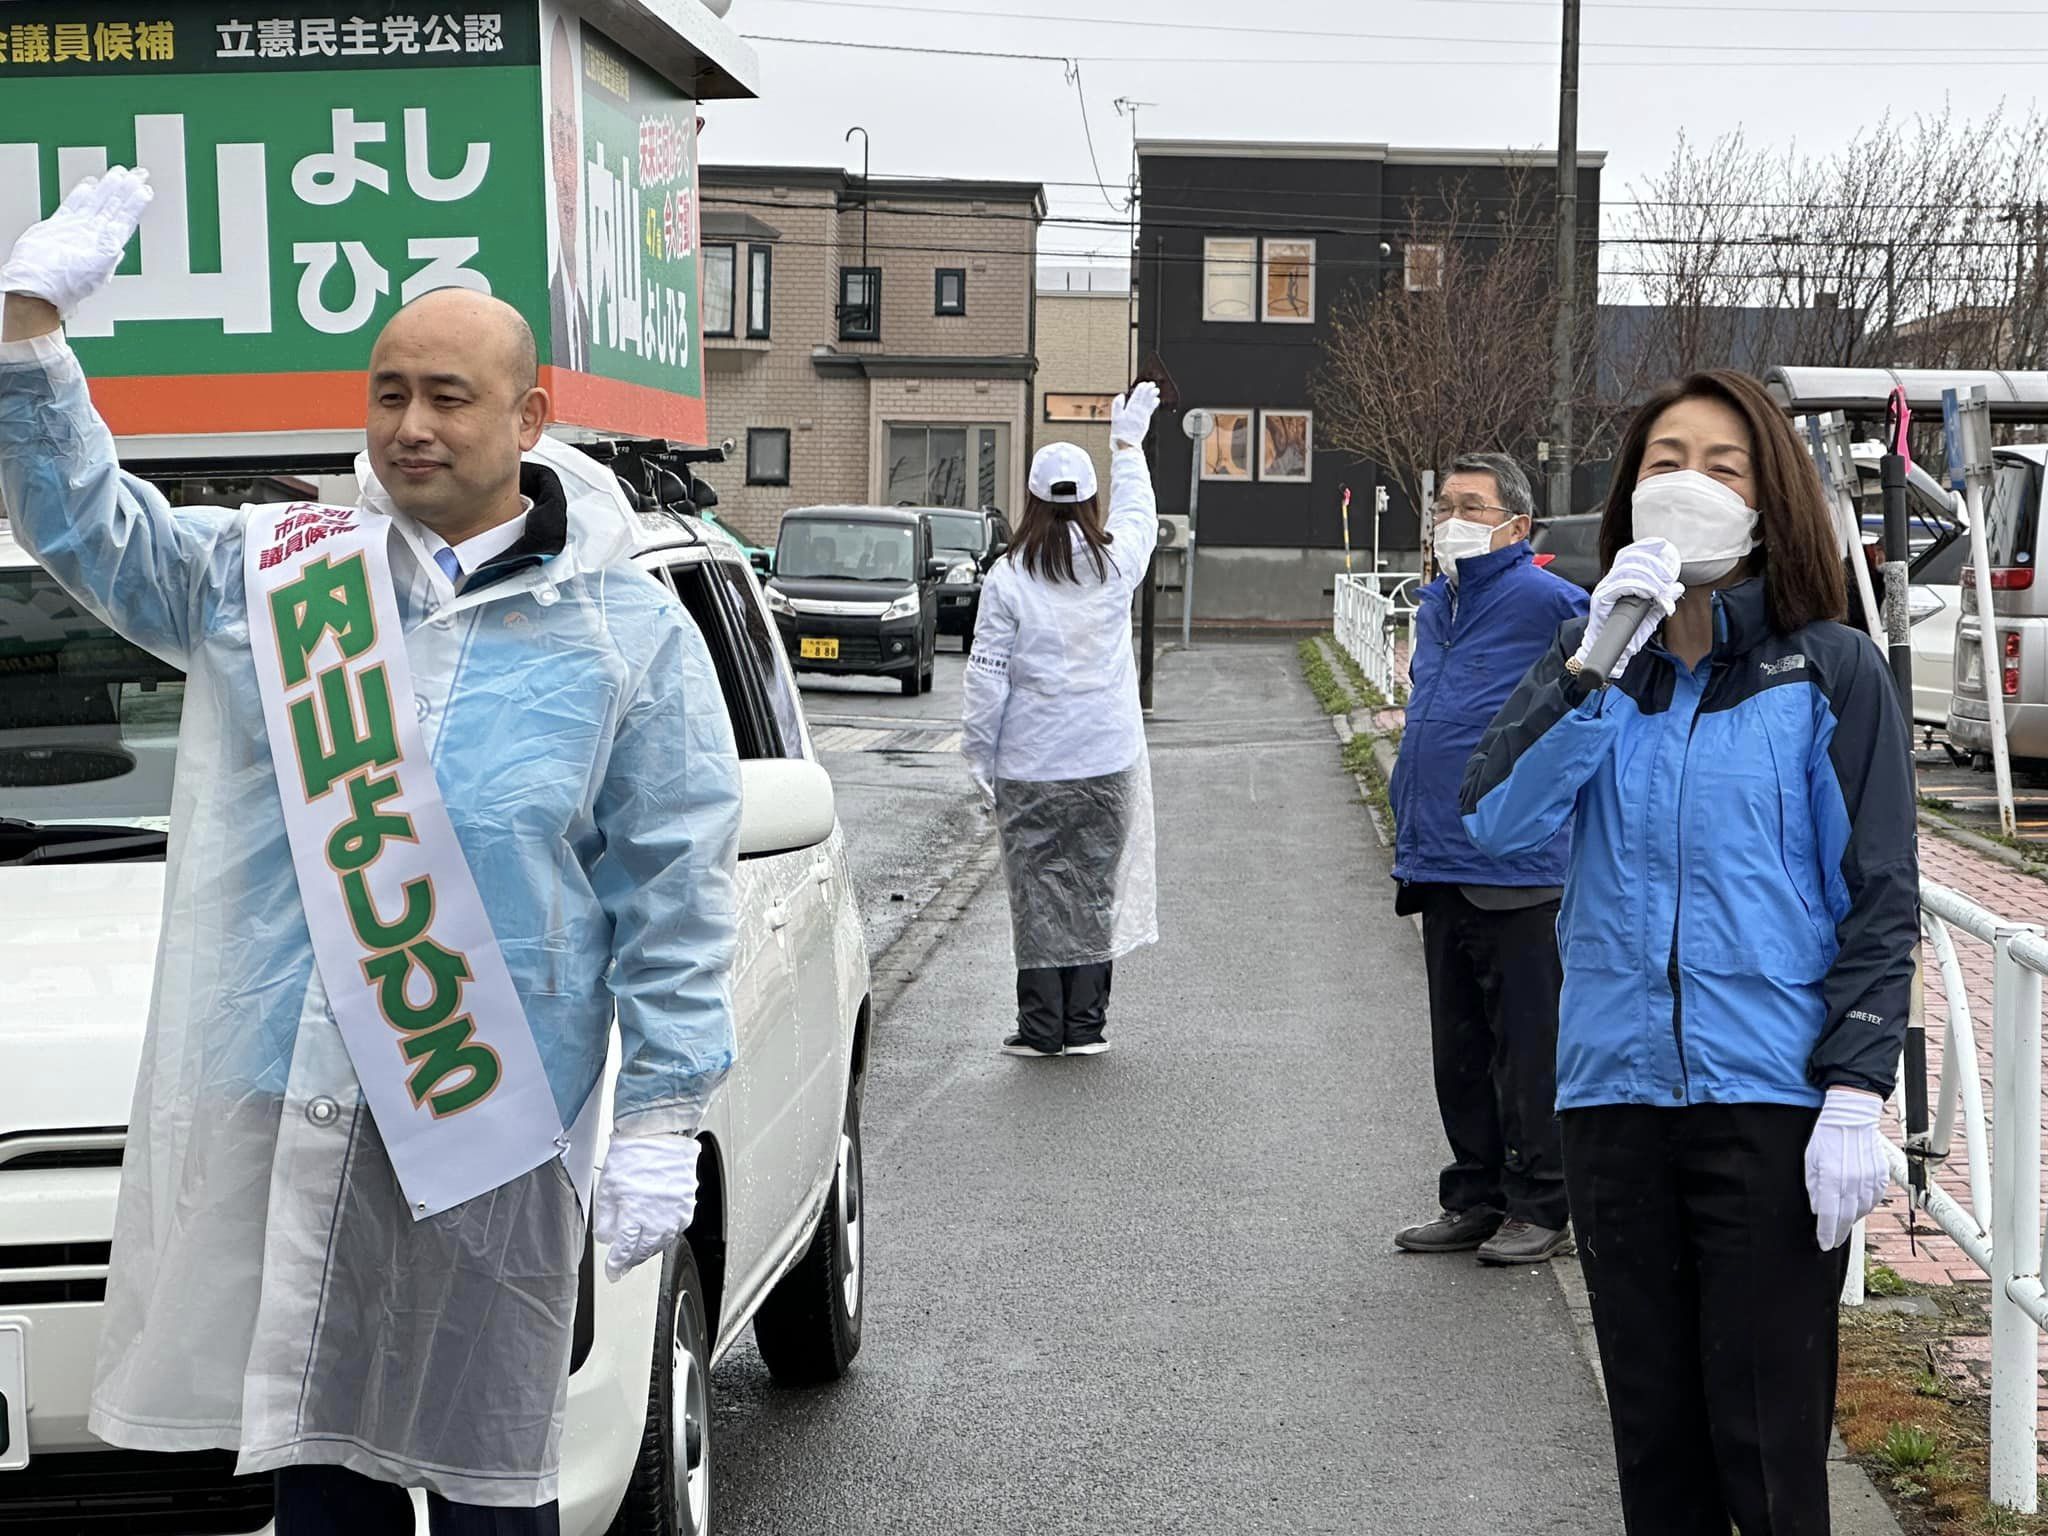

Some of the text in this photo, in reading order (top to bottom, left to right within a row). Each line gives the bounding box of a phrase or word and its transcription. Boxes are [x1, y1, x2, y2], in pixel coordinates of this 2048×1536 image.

[0, 15, 502, 63] 議員候補 立憲民主党公認
[0, 113, 272, 337] 山
[291, 108, 490, 205] よし
[587, 141, 642, 357] 内山
[643, 277, 688, 369] よしひろ
[267, 550, 503, 1121] 内山よしひろ
